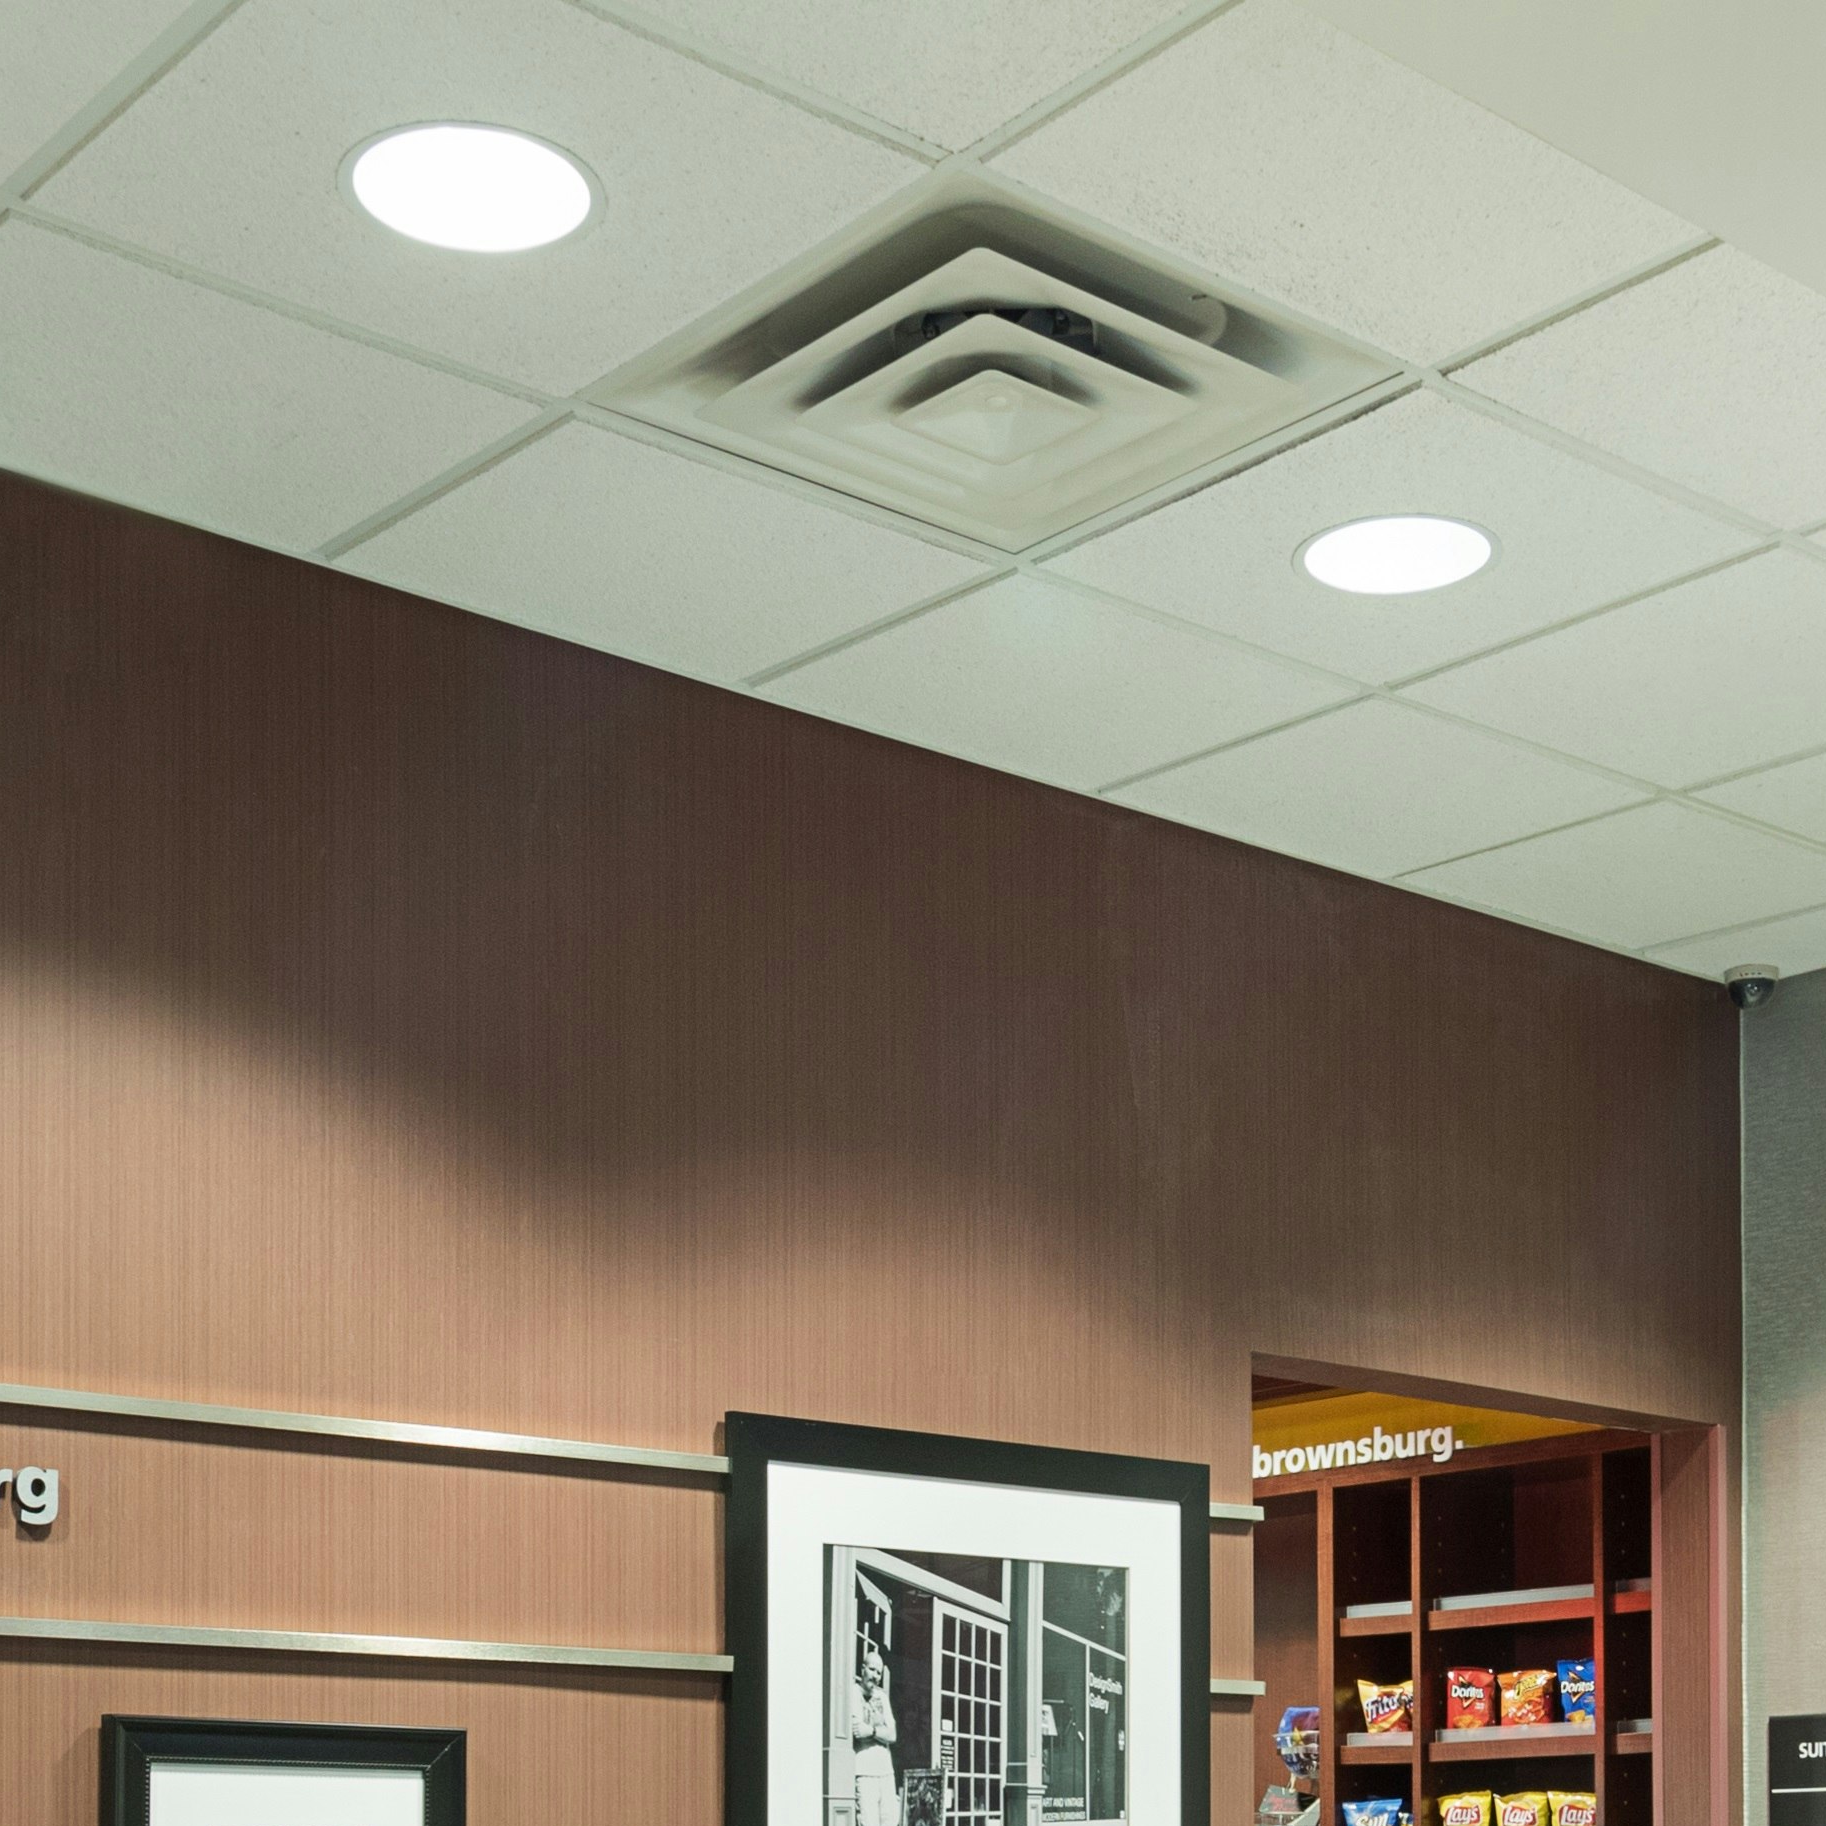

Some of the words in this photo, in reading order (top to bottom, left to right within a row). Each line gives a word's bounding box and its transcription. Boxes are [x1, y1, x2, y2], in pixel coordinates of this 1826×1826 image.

[1252, 1426, 1463, 1479] brownsburg.
[1451, 1685, 1484, 1699] Doritos
[1560, 1680, 1595, 1694] Doritos
